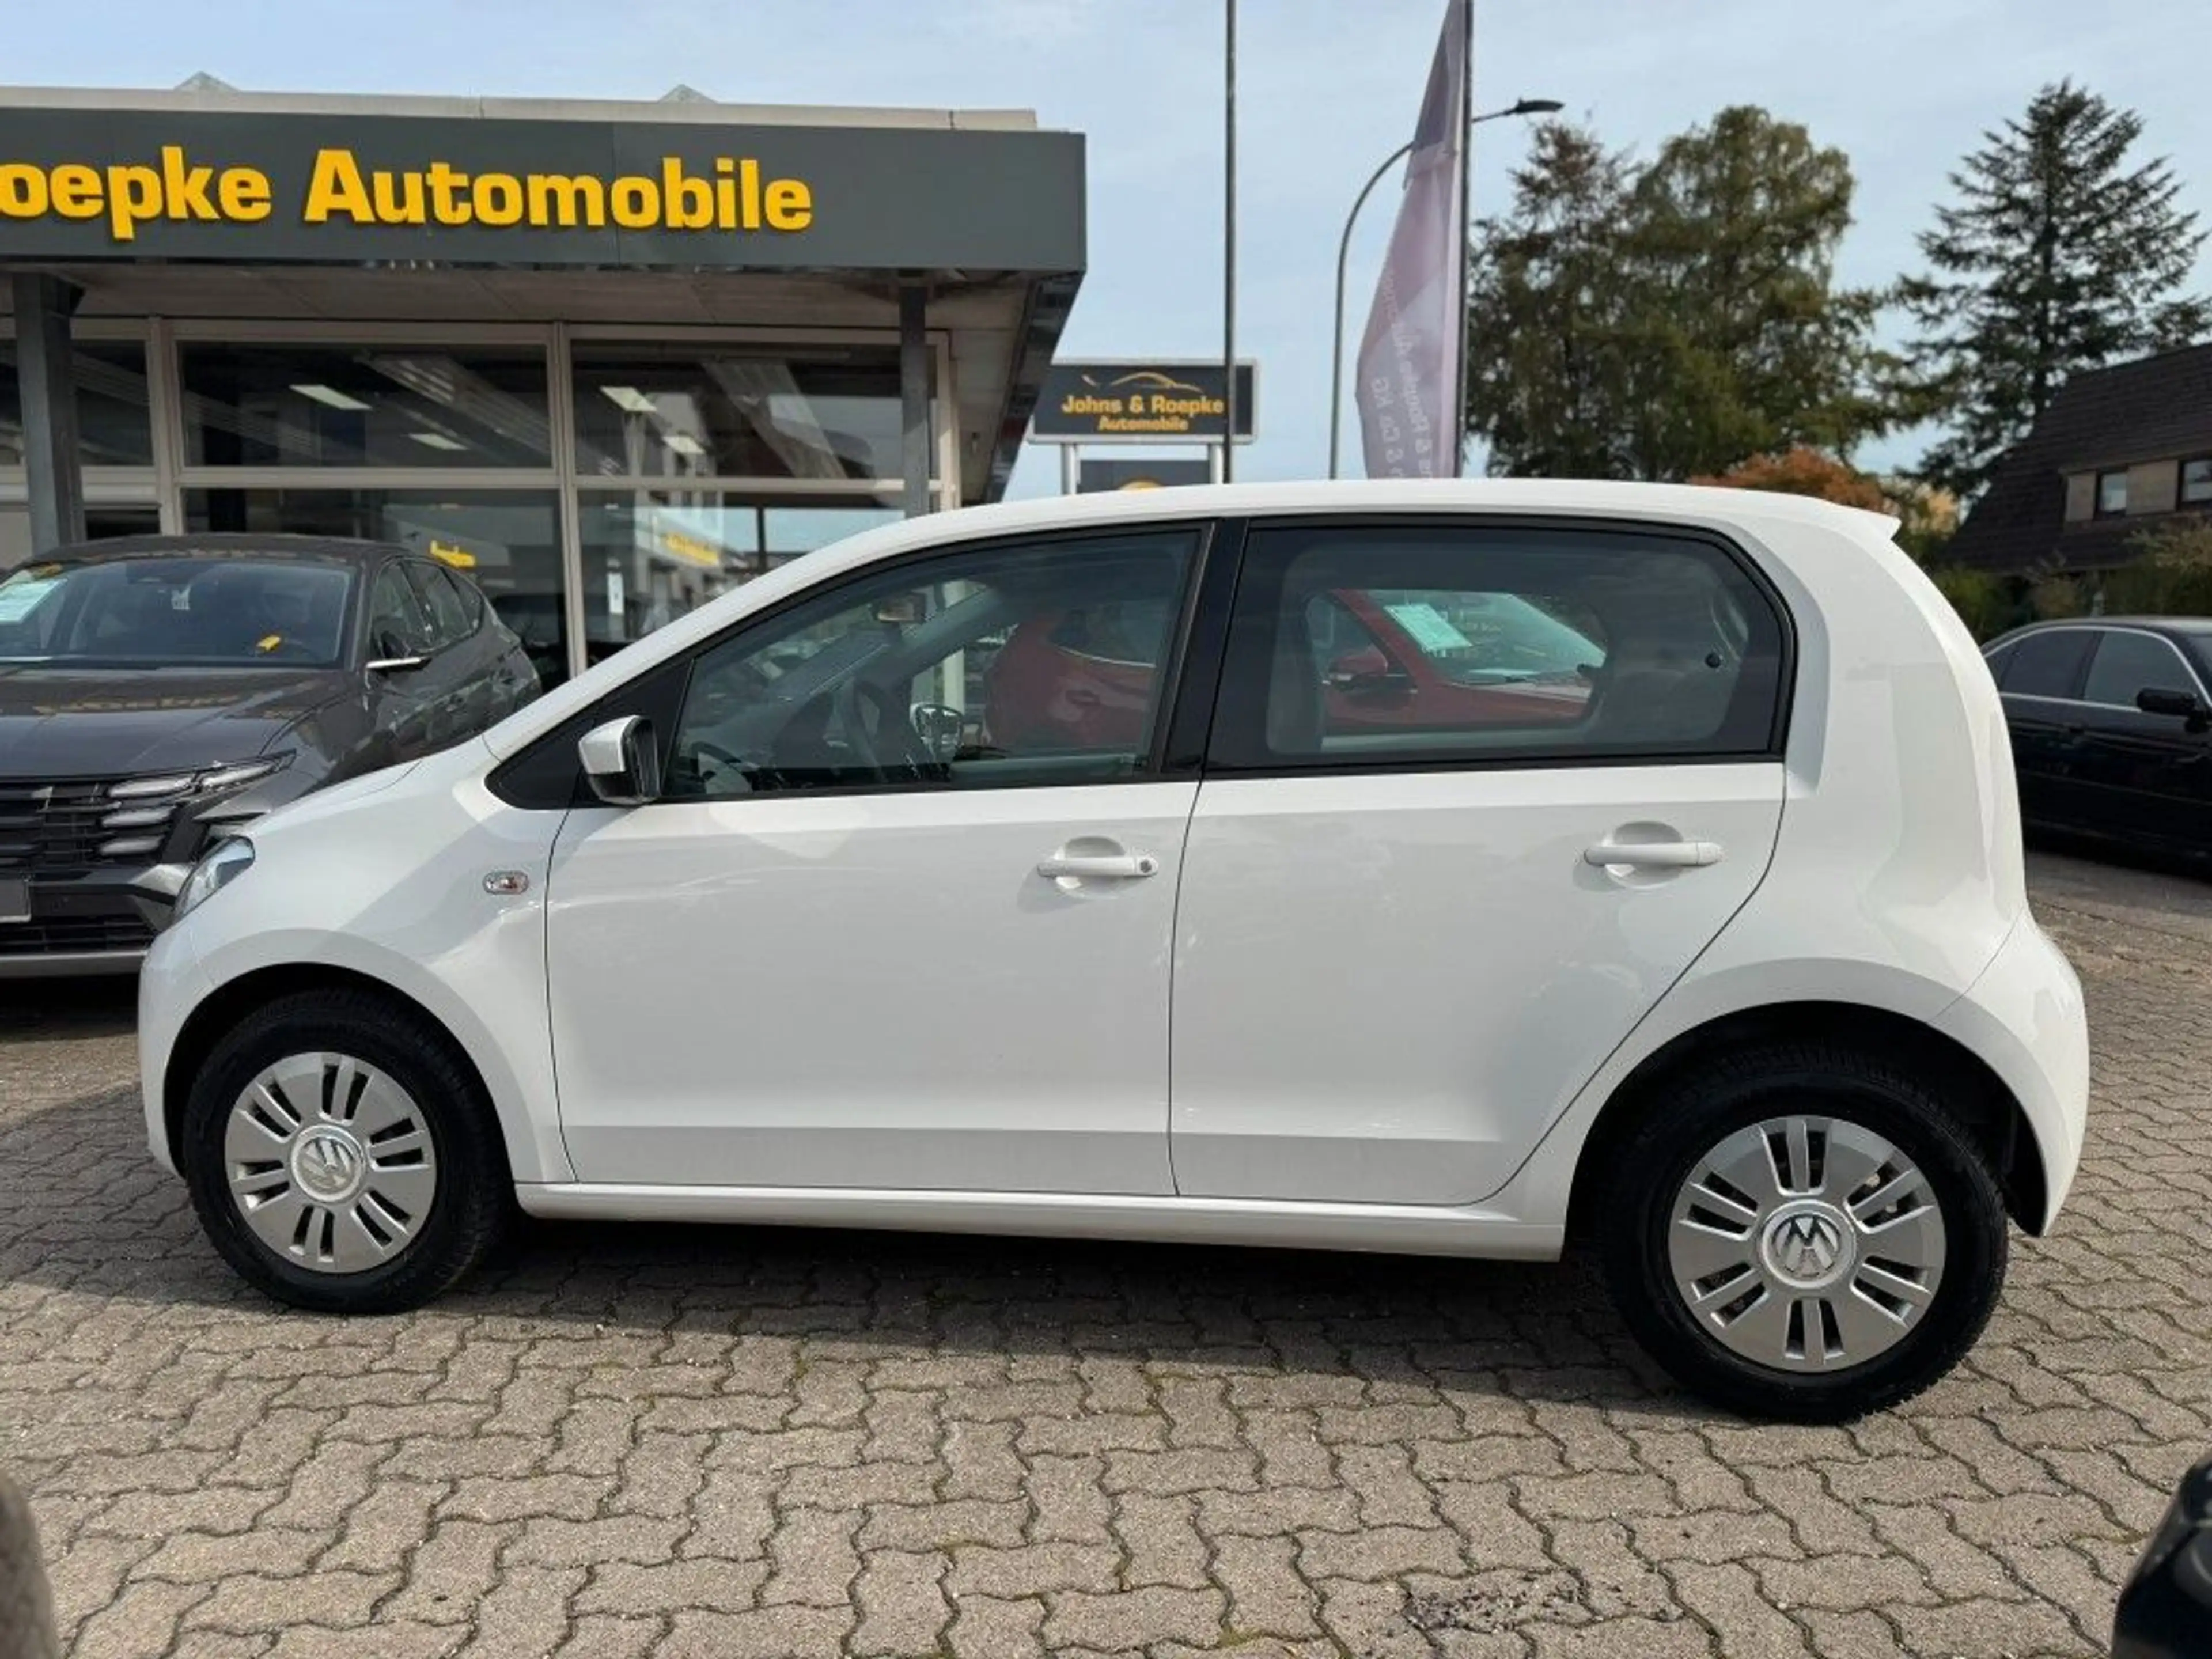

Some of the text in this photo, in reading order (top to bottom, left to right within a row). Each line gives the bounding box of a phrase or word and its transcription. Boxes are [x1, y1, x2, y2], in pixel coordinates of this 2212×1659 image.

[0, 146, 813, 240] oepke Automobile
[1062, 395, 1224, 418] Johns & Roepke
[1098, 416, 1189, 431] Automobile
